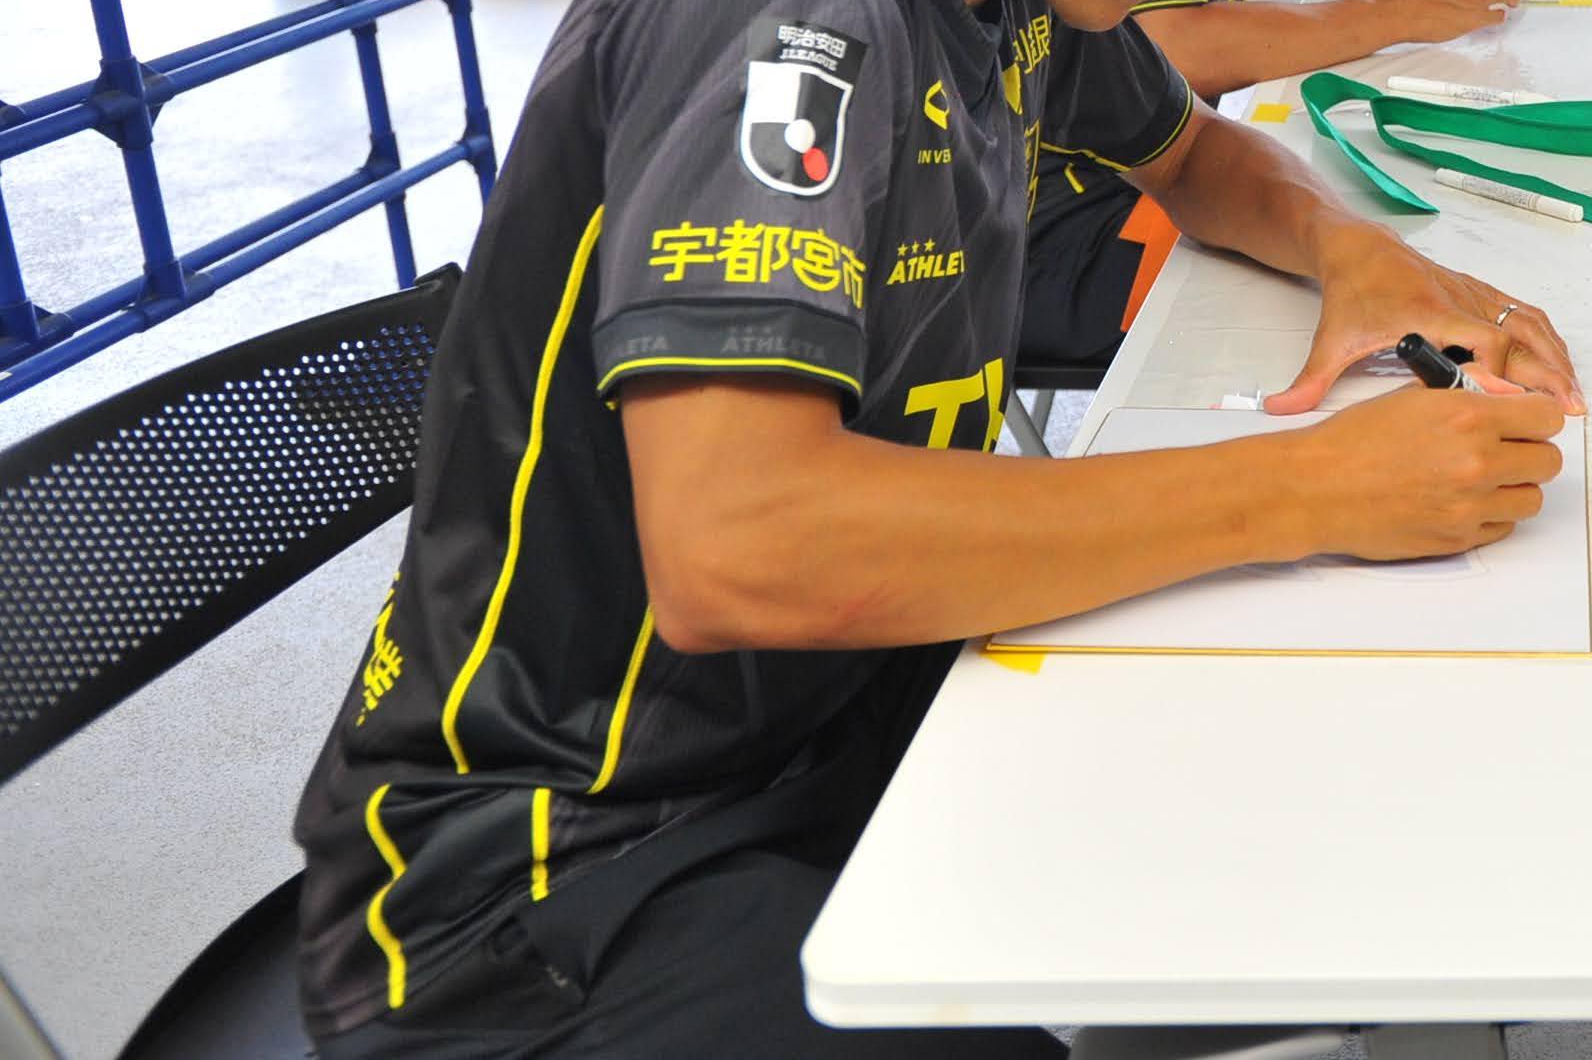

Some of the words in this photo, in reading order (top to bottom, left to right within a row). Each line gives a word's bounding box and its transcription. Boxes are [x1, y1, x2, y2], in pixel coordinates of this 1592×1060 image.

[777, 25, 847, 59] 明治安田
[649, 219, 867, 309] 宇都宮市
